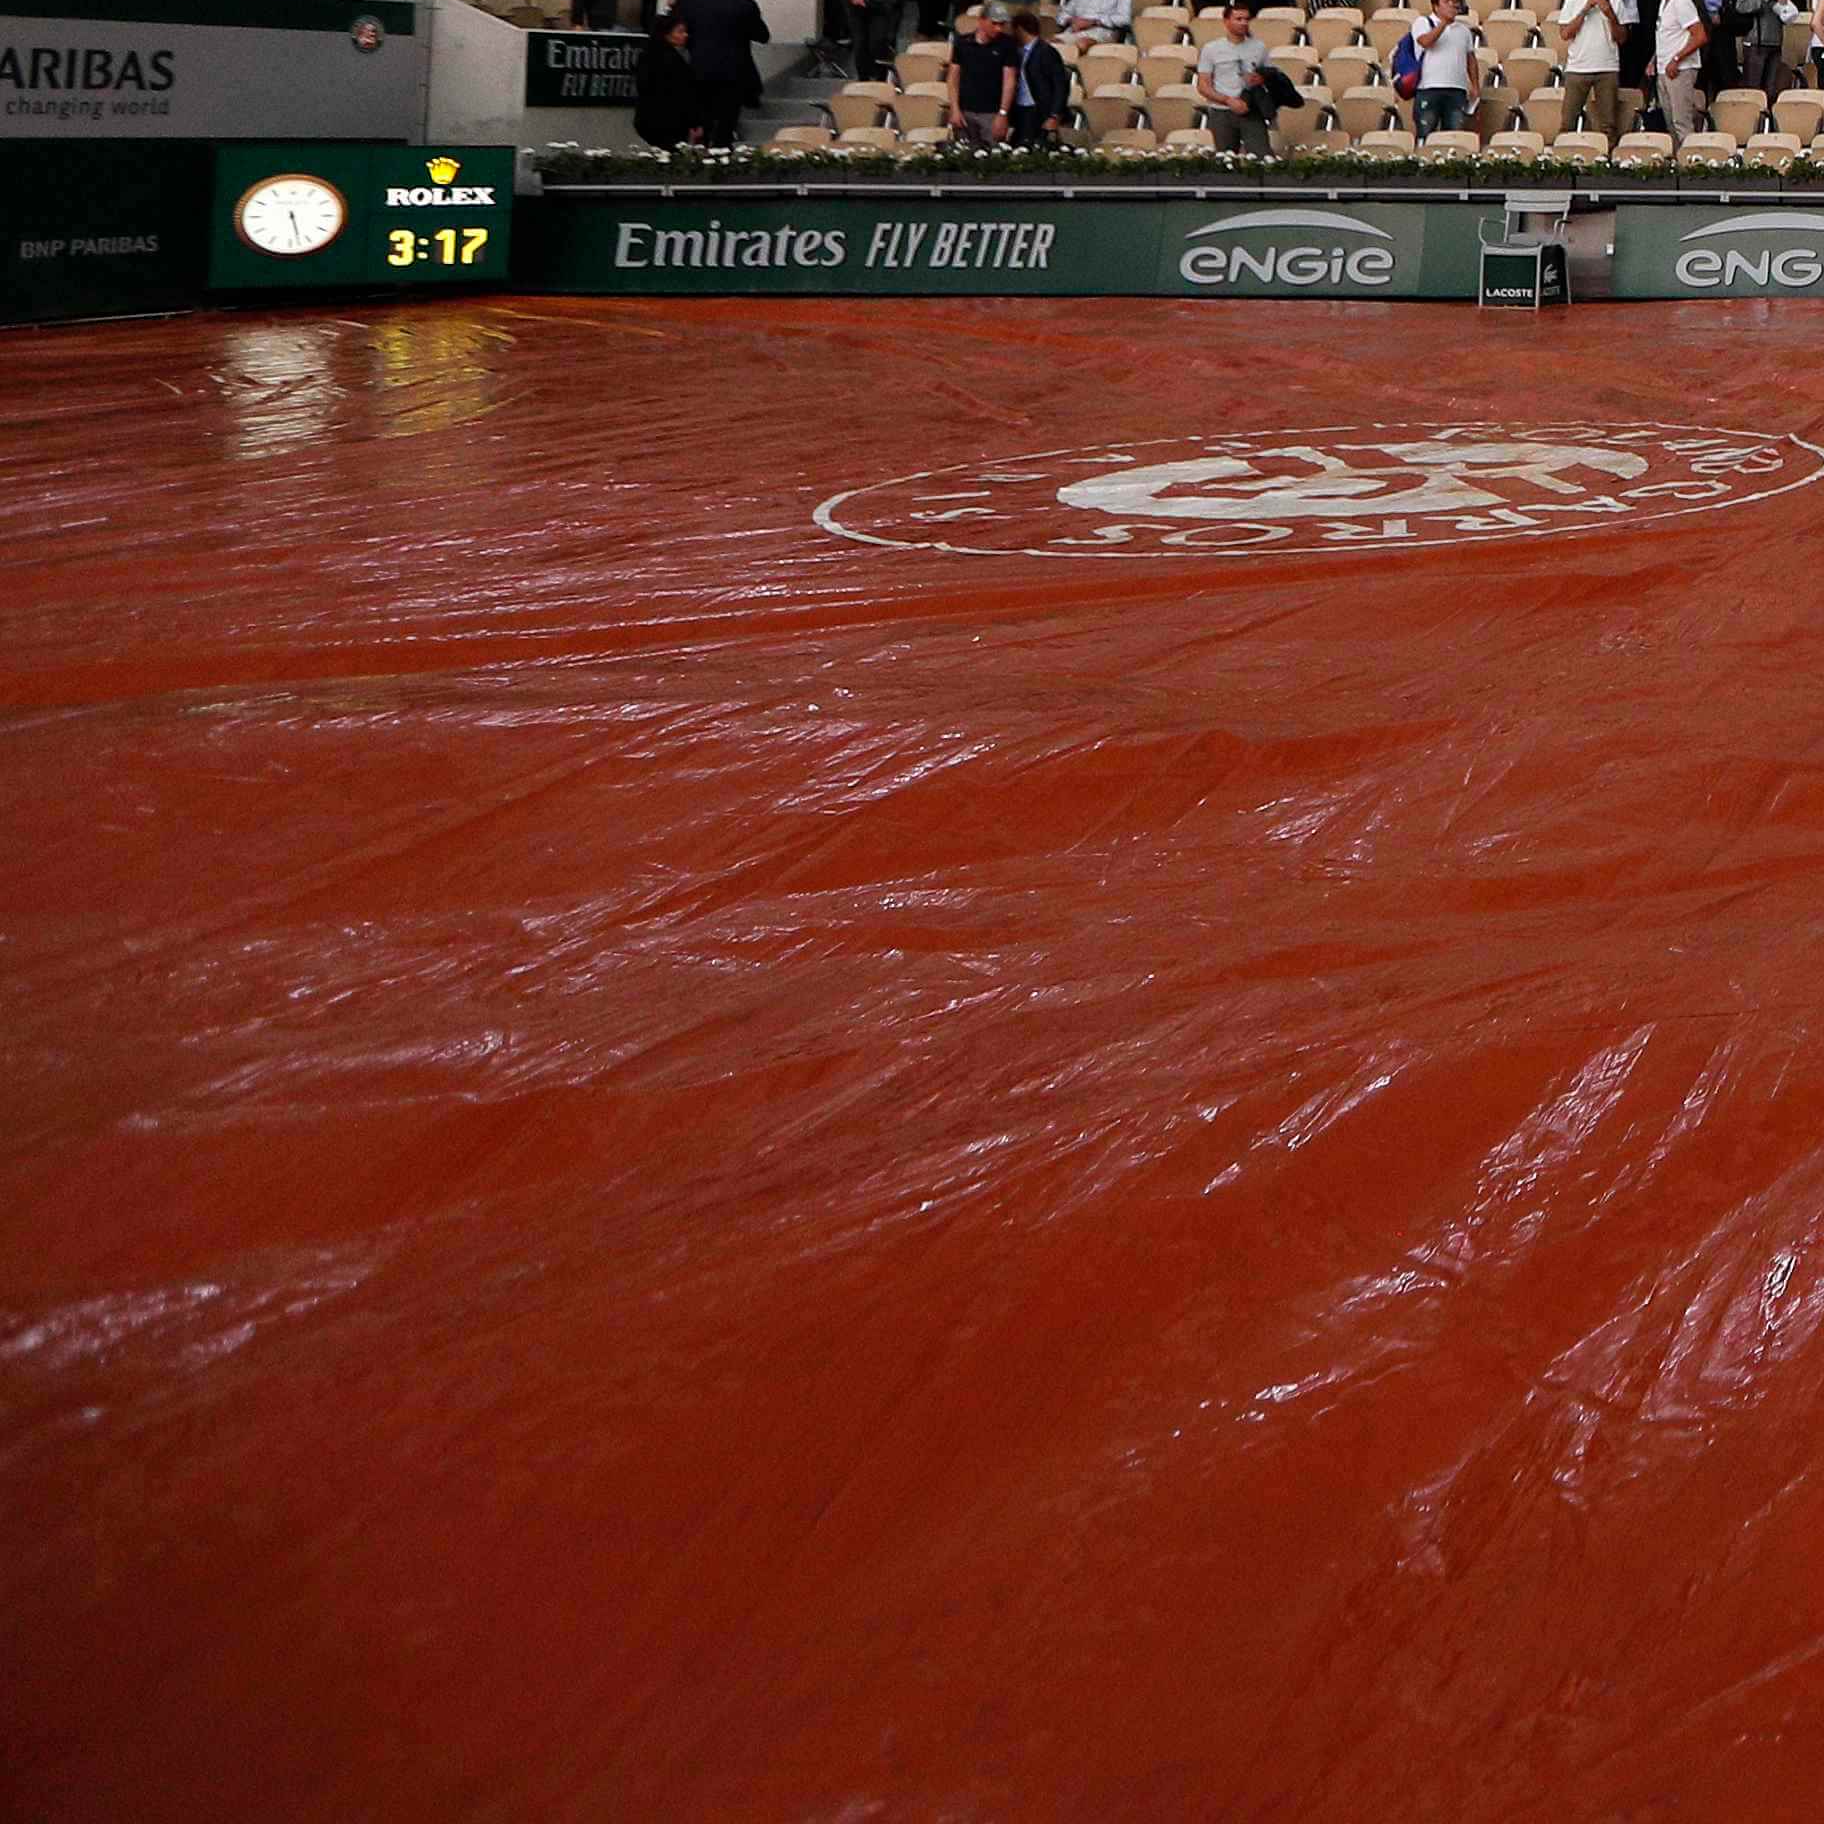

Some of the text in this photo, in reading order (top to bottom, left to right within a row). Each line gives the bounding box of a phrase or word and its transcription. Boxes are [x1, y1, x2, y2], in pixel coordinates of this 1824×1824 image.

[546, 39, 643, 70] Emirat
[6, 96, 171, 121] changing world
[386, 187, 496, 206] ROLEX
[20, 235, 160, 259] BNP PARIBAS
[387, 228, 489, 266] 3:17
[615, 220, 1056, 269] Emirates FLY BETTER
[1486, 287, 1534, 299] LACOSTE
